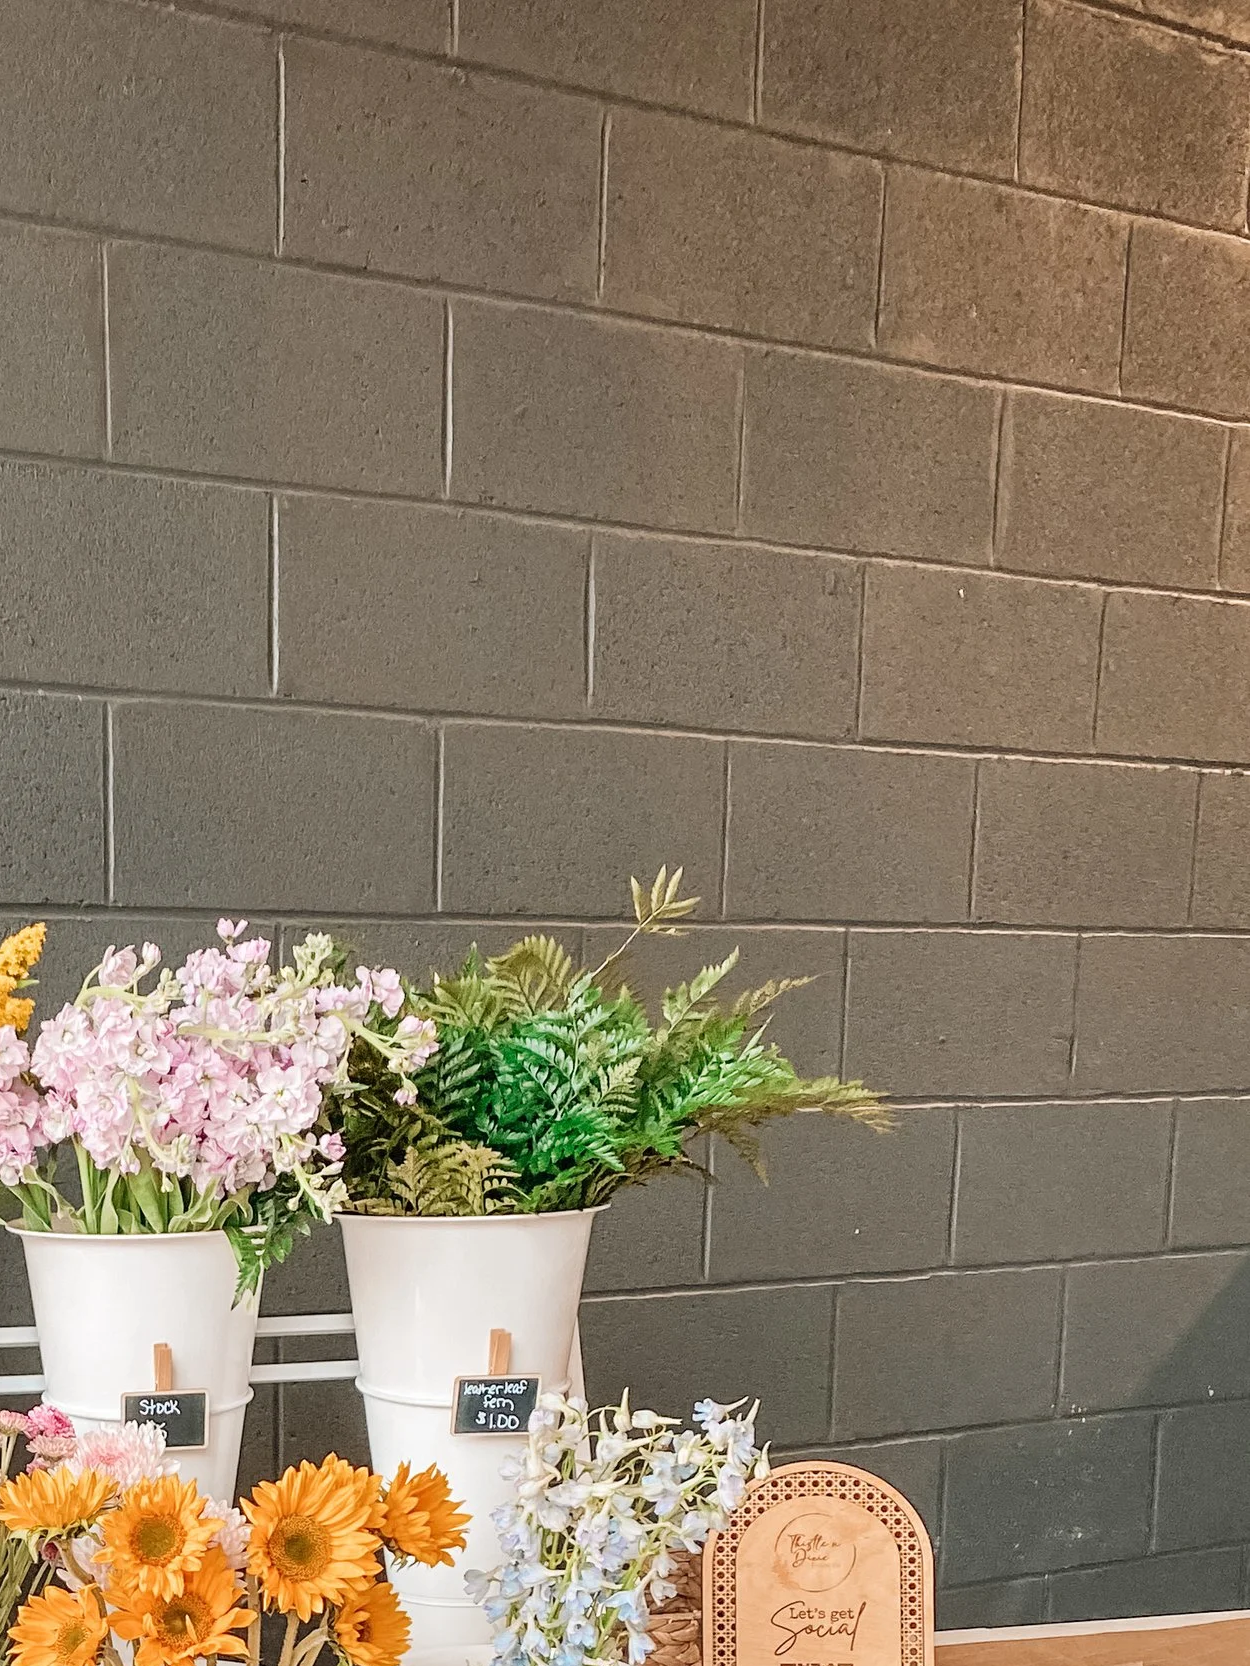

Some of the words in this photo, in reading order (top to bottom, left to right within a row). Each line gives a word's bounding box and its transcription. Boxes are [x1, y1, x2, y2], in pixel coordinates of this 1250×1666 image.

[483, 1395, 515, 1411] fern
[475, 1411, 520, 1429] $1.00
[789, 1607, 826, 1619] Let's
[830, 1607, 855, 1623] get
[770, 1600, 867, 1656] Social
